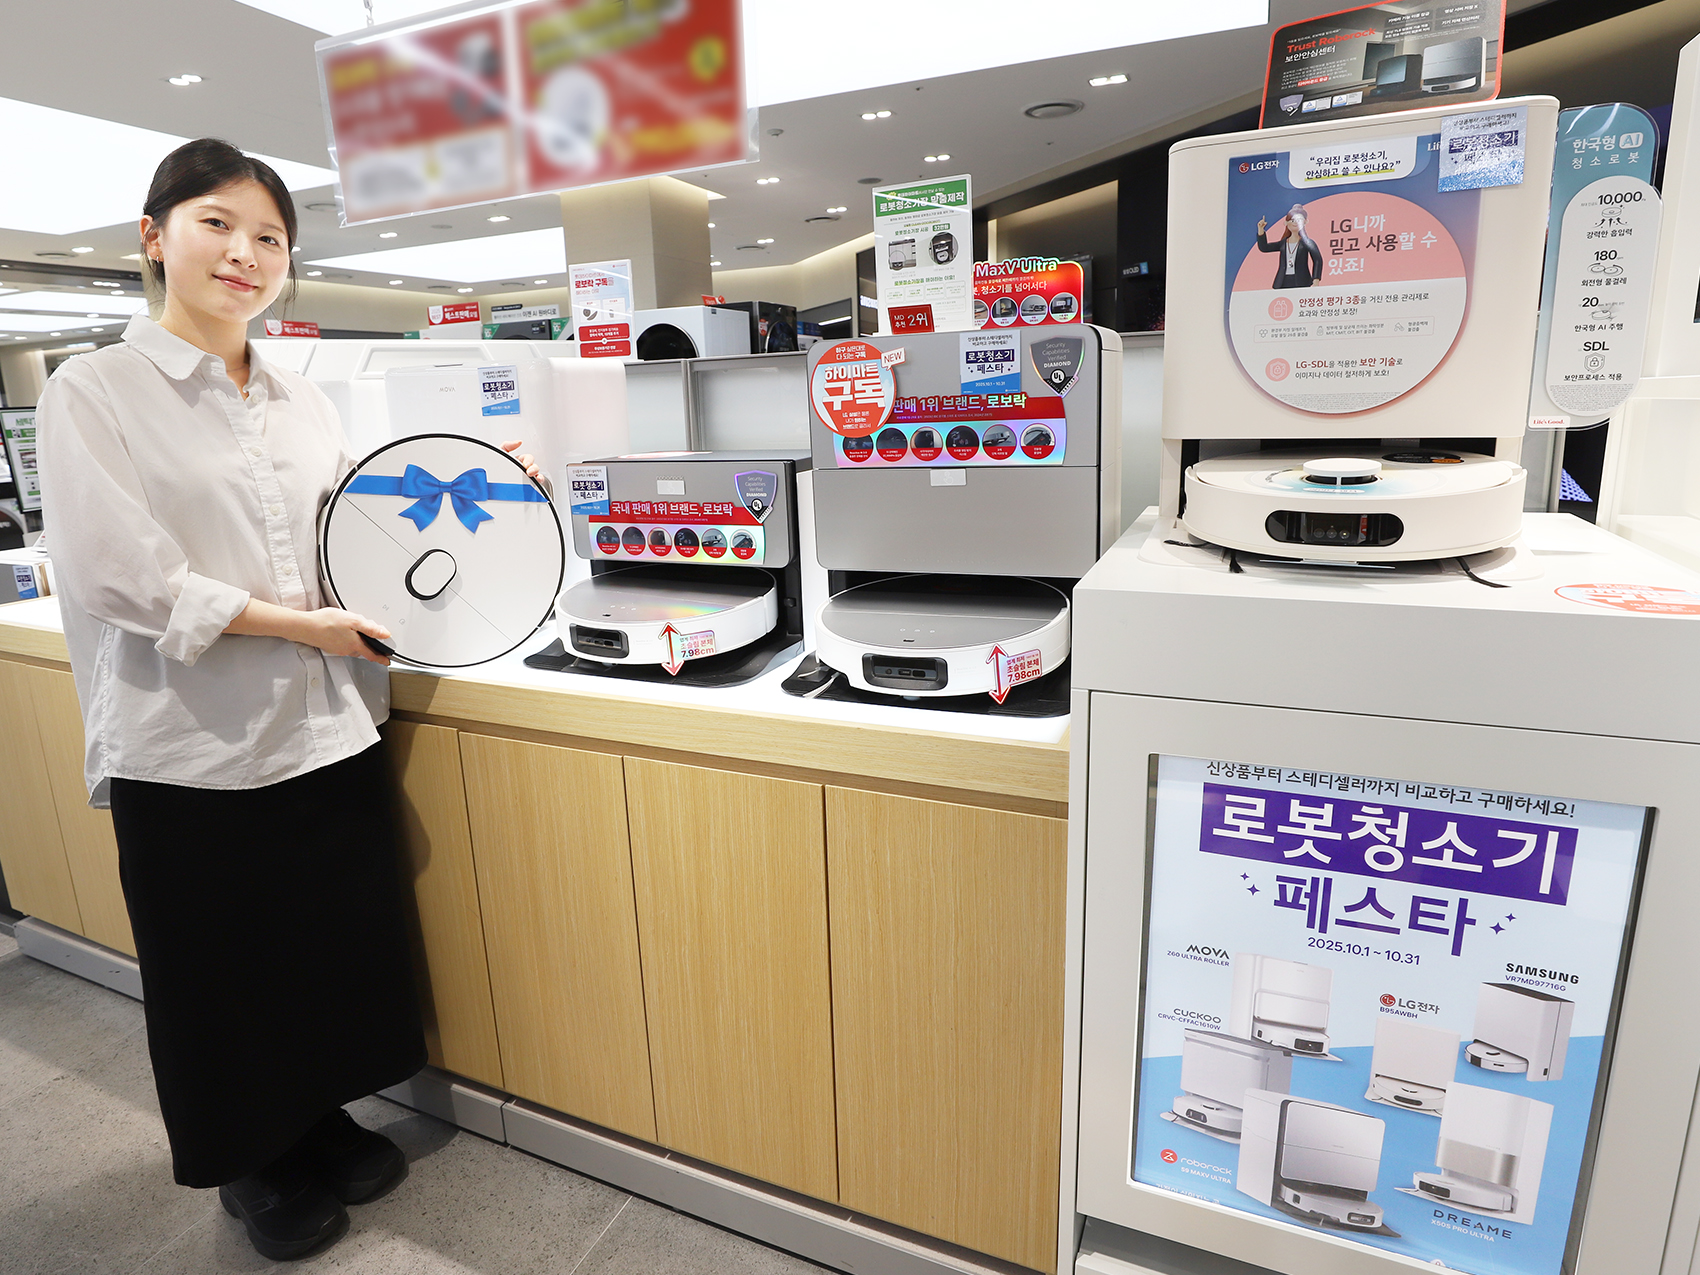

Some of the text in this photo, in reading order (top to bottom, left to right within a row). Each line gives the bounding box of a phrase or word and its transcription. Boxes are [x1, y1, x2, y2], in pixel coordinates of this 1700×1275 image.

[1287, 40, 1317, 53] Trust
[1319, 28, 1377, 46] Roborock
[1284, 45, 1336, 63] 보안안심센터
[1572, 134, 1640, 154] 한국형 AI
[1344, 150, 1388, 164] 로봇청소기,
[1251, 161, 1280, 172] LG전자
[1306, 168, 1340, 180] 안심하고
[1341, 166, 1350, 177] 쓸
[1352, 166, 1362, 175] 수
[1598, 191, 1642, 206] 10,000
[1330, 214, 1386, 234] LG니까
[1586, 228, 1632, 240] 강력한 흡입력
[1330, 230, 1438, 255] 믿고 사용할 수
[1594, 250, 1618, 261] 180
[976, 260, 1057, 278] MaxV Ultra
[1328, 258, 1364, 276] 있죠!
[575, 280, 594, 288] 로보락
[980, 283, 1013, 296] 청소기를
[1015, 280, 1048, 292] 넘어서다
[1581, 277, 1628, 287] 회전형 물걸레
[1299, 298, 1324, 308] 안정성
[1326, 296, 1344, 306] 평가
[1346, 295, 1367, 305] 3종을
[1401, 292, 1430, 302] 관리제로
[1582, 296, 1599, 308] 20
[1320, 308, 1340, 317] 안정성
[895, 312, 928, 329] 추천 2위
[1608, 322, 1624, 331] 주행
[1042, 348, 1071, 356] Capabilities
[1046, 342, 1066, 350] Security
[1583, 341, 1610, 352] SDL
[842, 352, 854, 360] 되는
[855, 351, 867, 359] 구독
[884, 352, 903, 364] NEW
[967, 350, 1013, 363] 로봇청소기
[1296, 356, 1403, 369] LG-SDL을 적용한 보안 기술로
[824, 362, 880, 380] 하이마트
[976, 362, 1004, 374] 페스타
[1044, 360, 1072, 369] DIAMOND
[1054, 372, 1062, 382] UL
[1294, 371, 1321, 380] 이미지나
[1322, 370, 1342, 379] 데이터
[1564, 372, 1622, 382] 보안프로세스 적용
[484, 380, 514, 392] 로봇청소기
[822, 378, 886, 411] 구독
[894, 393, 1028, 414] 판매 1위 브랜드, 로보락
[574, 481, 604, 490] 로봇청소기
[612, 502, 630, 515] 국내
[632, 502, 651, 515] 판매
[652, 502, 668, 516] 1위
[670, 503, 702, 517] 브랜드,
[702, 502, 734, 517] 로보락
[680, 638, 714, 650] 초슬림 본체
[681, 648, 714, 658] 7.98cm
[1007, 658, 1040, 674] 초슬림 본체
[1008, 668, 1040, 683] 7.98cm
[1206, 760, 1575, 819] 신상품부터 스테디셀러까지 비교하고 구매하세요!
[1212, 793, 1560, 896] 로봇청소기
[1273, 875, 1476, 957] 페스타
[1168, 950, 1230, 967] Z60 ULTRA ROLLER
[1186, 944, 1230, 960] MOVA
[1307, 936, 1370, 957] 2025.10.1
[1384, 949, 1421, 966] 10.31
[1506, 962, 1580, 985] SAMSUNG
[1505, 974, 1567, 992] VR7MD97716G
[1380, 1006, 1418, 1020] B95AWBH
[1398, 998, 1440, 1015] LG전자
[1174, 1008, 1222, 1024] CUCKOO
[1180, 1157, 1232, 1176] roborock
[1190, 1169, 1210, 1179] MAXV
[1210, 1174, 1232, 1185] ULTRA
[1430, 1218, 1496, 1243] X50S PRO ULTRA
[1434, 1209, 1513, 1240] DREAME
